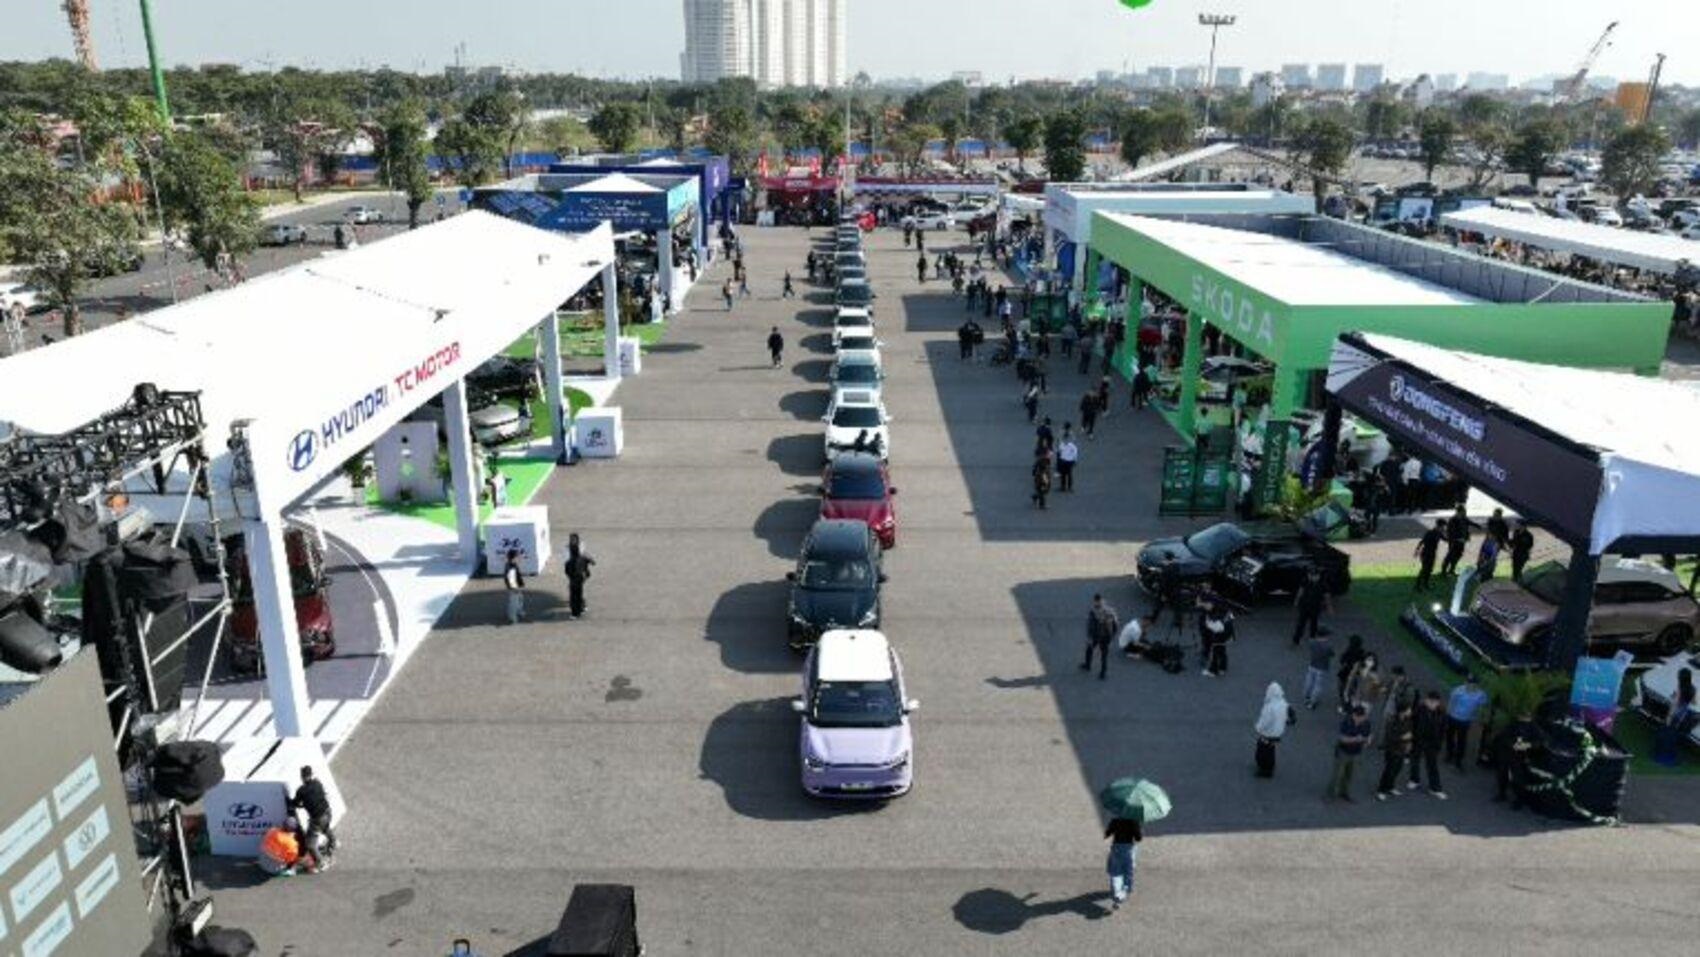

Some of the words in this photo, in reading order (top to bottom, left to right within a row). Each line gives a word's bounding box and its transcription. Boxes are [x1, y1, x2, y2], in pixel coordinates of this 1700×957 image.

[322, 384, 389, 448] HYUNDAI
[394, 370, 414, 397] TC
[415, 341, 461, 385] MOTOR
[1404, 386, 1485, 441] DONGFENG
